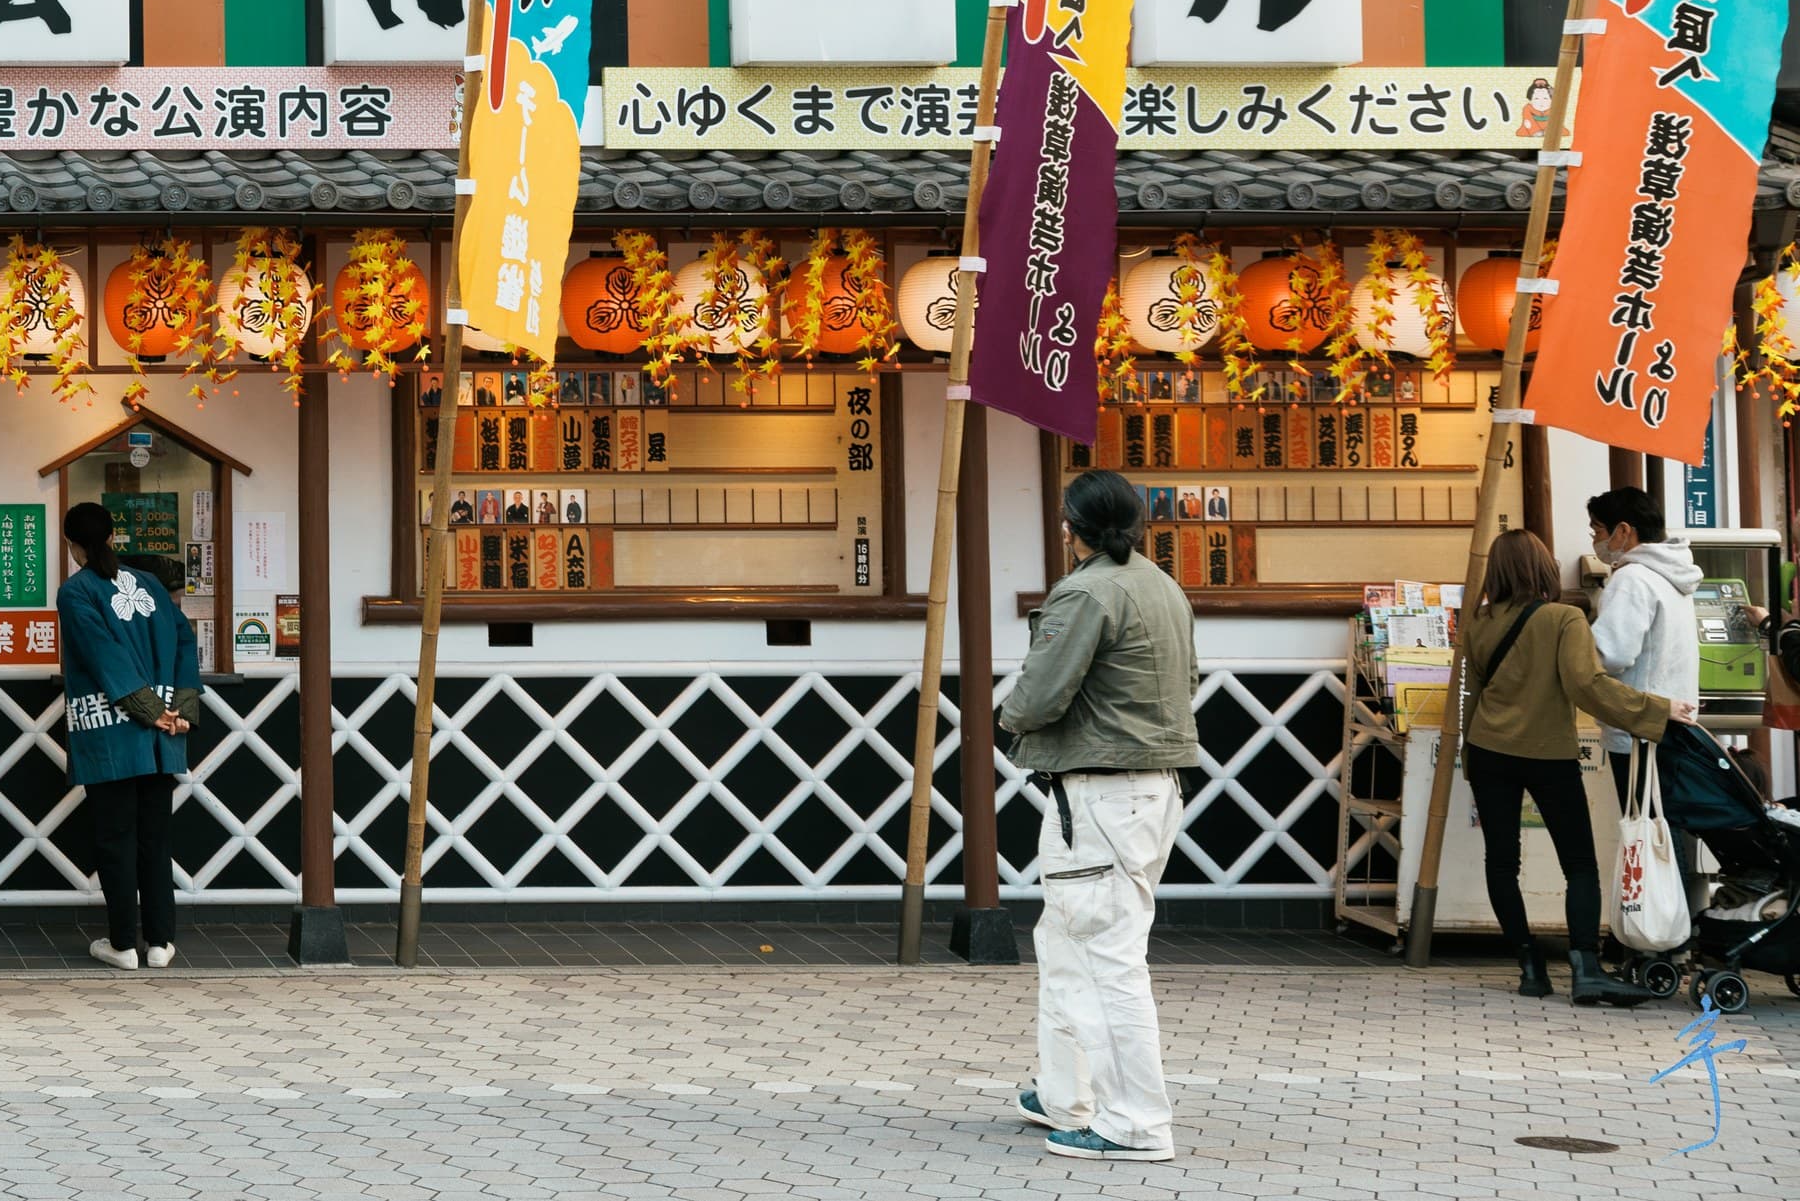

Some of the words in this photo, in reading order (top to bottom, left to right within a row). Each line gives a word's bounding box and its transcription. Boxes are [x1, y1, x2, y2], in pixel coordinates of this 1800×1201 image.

[619, 83, 1511, 138] 心ゆくまで演芸楽しみください
[847, 386, 874, 472] 夜の部
[24, 514, 36, 592] お酒を飲んでいる方の
[566, 534, 585, 588] A太郎
[856, 541, 868, 585] 16時40分
